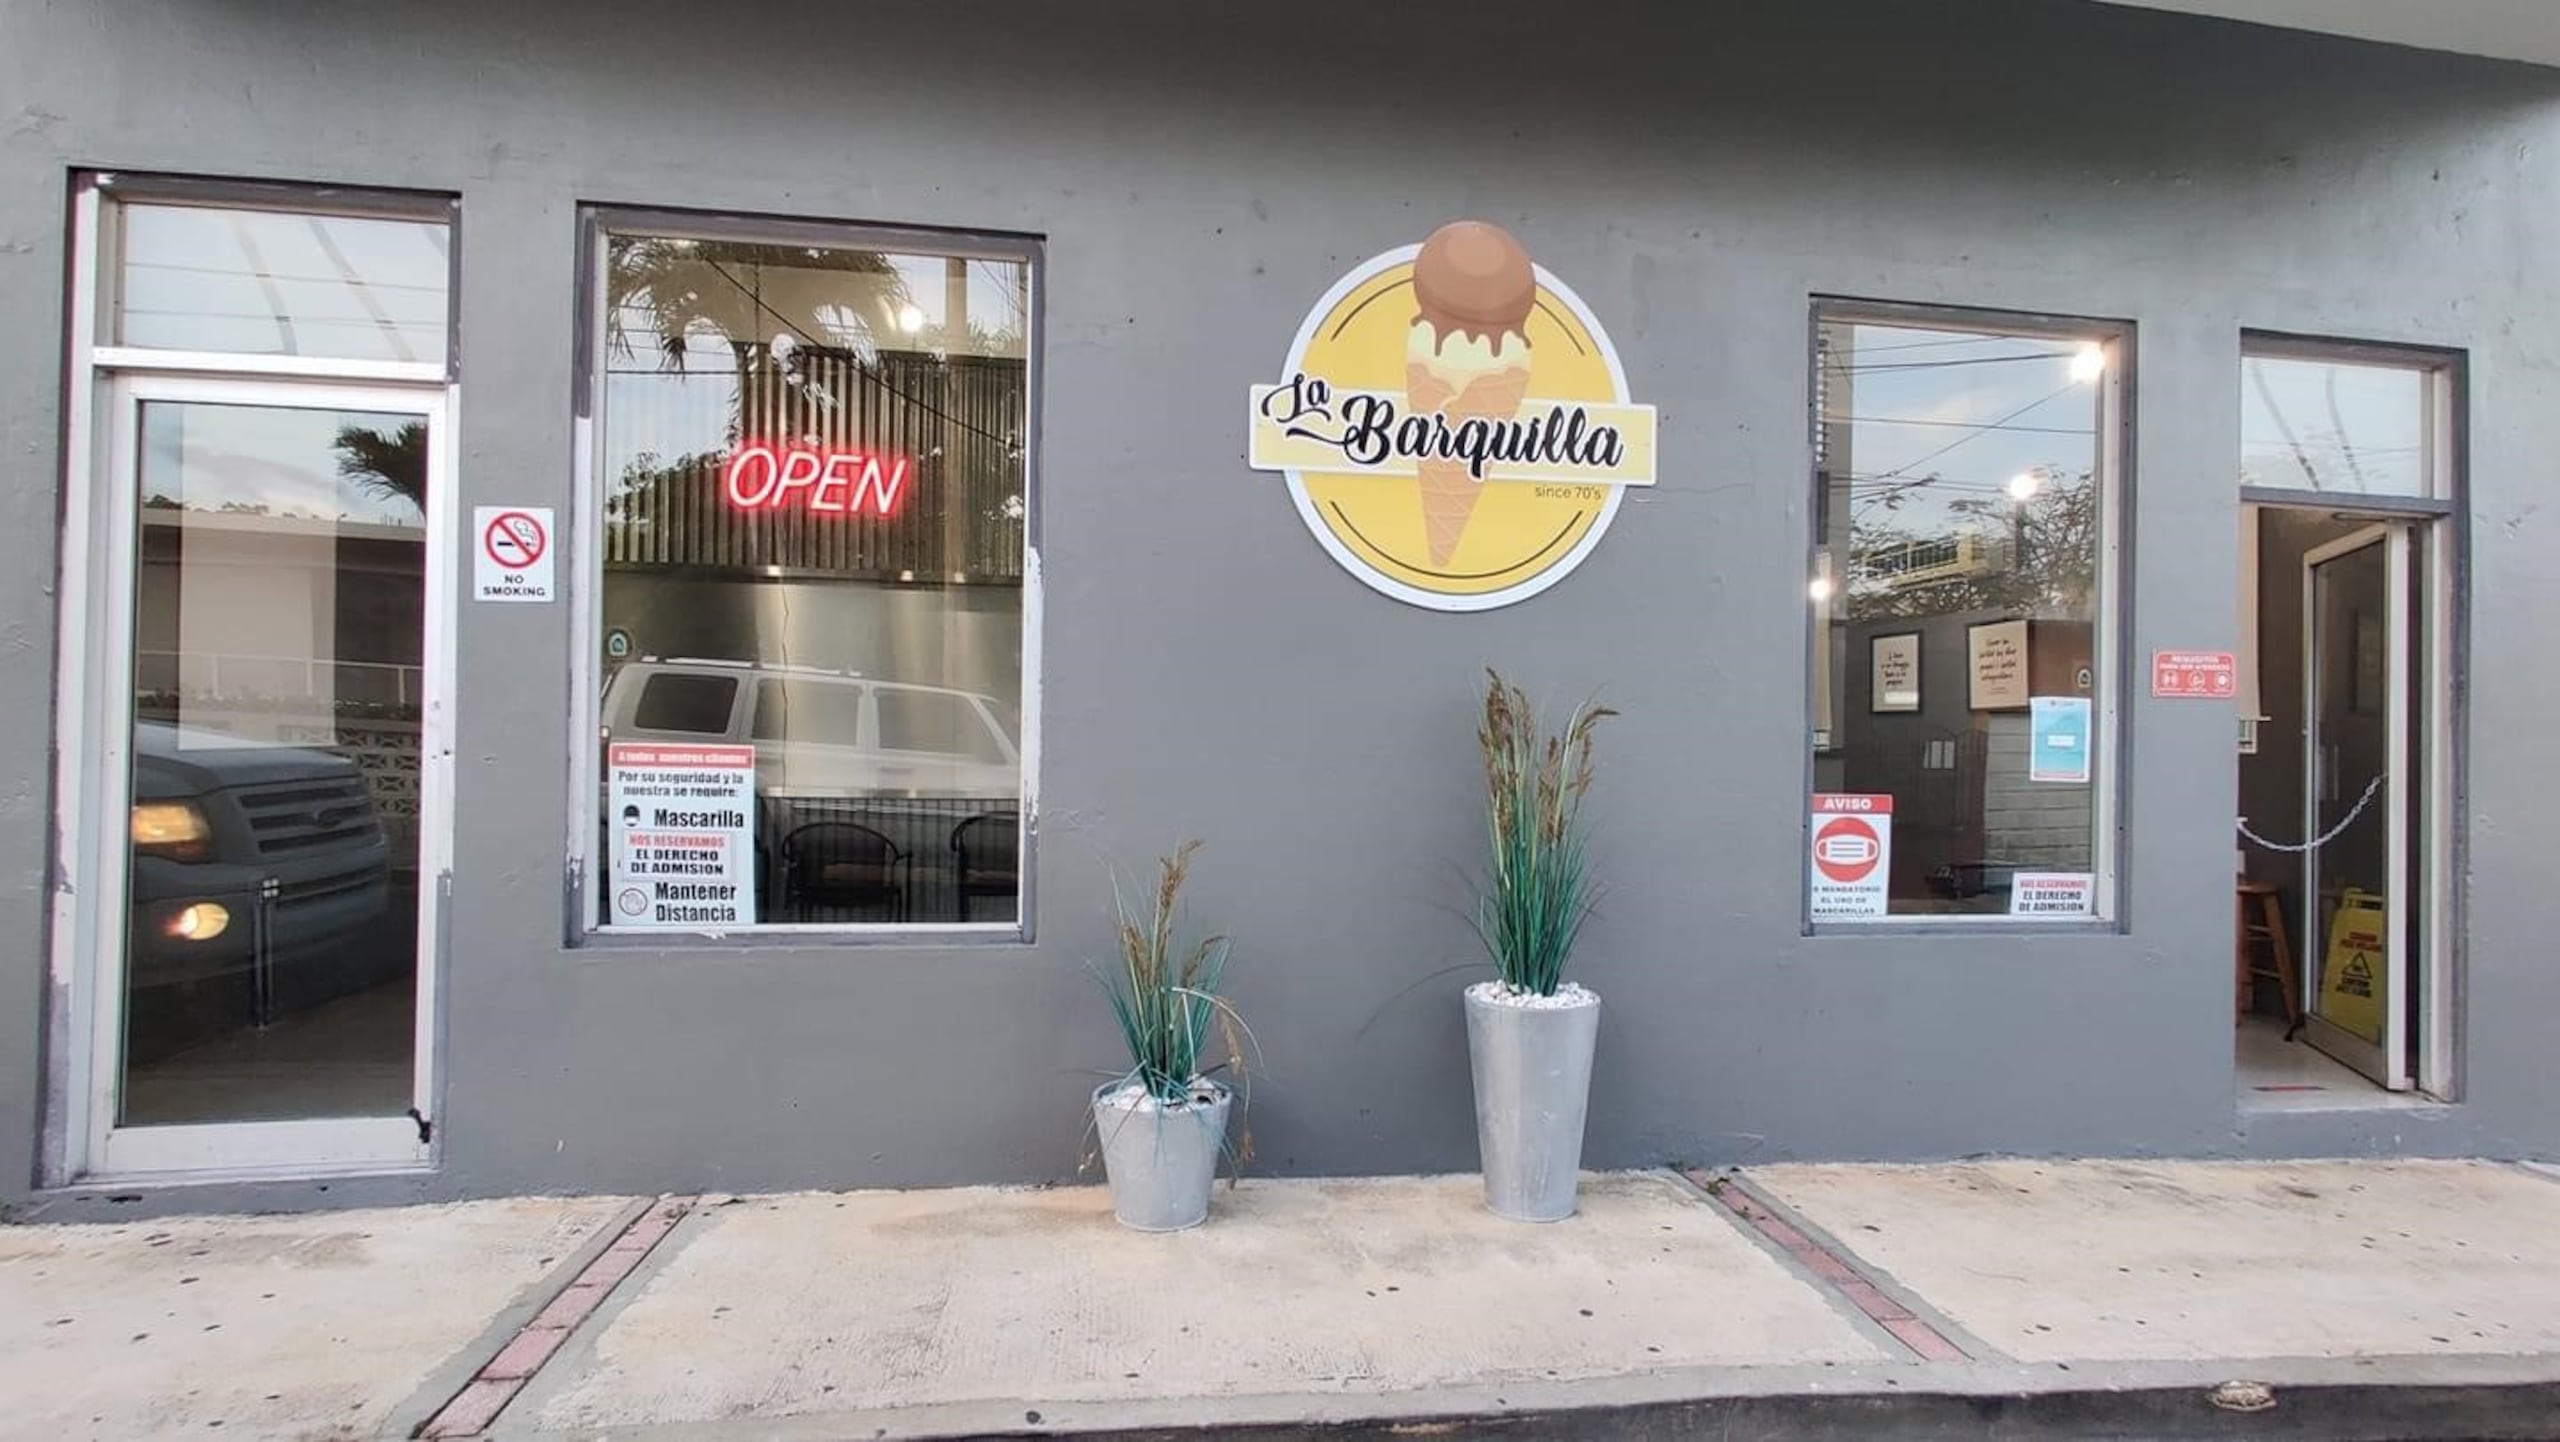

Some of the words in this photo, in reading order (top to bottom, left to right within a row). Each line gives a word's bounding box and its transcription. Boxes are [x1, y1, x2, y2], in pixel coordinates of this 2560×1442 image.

[1262, 374, 1331, 423] La
[1287, 395, 1624, 478] Barquilla
[729, 447, 906, 513] OPEN
[1536, 485, 1572, 498] since
[1574, 486, 1602, 500] 70's
[504, 575, 524, 584] NO
[483, 587, 546, 596] SMOKING
[618, 771, 638, 782] Por
[642, 772, 656, 783] su
[658, 772, 720, 785] seguridad
[723, 775, 730, 784] y
[732, 773, 744, 783] la
[623, 785, 670, 796] nuestra
[674, 786, 687, 796] se
[1823, 797, 1872, 811] AVISO
[654, 808, 744, 828] Mascarilla
[629, 834, 651, 846] NOS
[654, 835, 725, 847] RESERVAMOS
[636, 848, 650, 860] EL
[654, 849, 719, 861] DERECHO
[631, 862, 649, 873] DE
[651, 862, 724, 874] ADMISION
[655, 881, 737, 900] Mantener
[1822, 885, 1881, 893] MANDATORIO
[2023, 891, 2033, 900] EL
[2035, 891, 2082, 900] DERECHO
[1820, 896, 1832, 905] EL
[1834, 896, 1853, 905] USO
[1855, 896, 1867, 905] DE
[2019, 902, 2031, 911] DE
[2033, 902, 2084, 911] ADMISION
[655, 904, 737, 921] Distancia
[1813, 907, 1875, 915] MASCARILLAS
